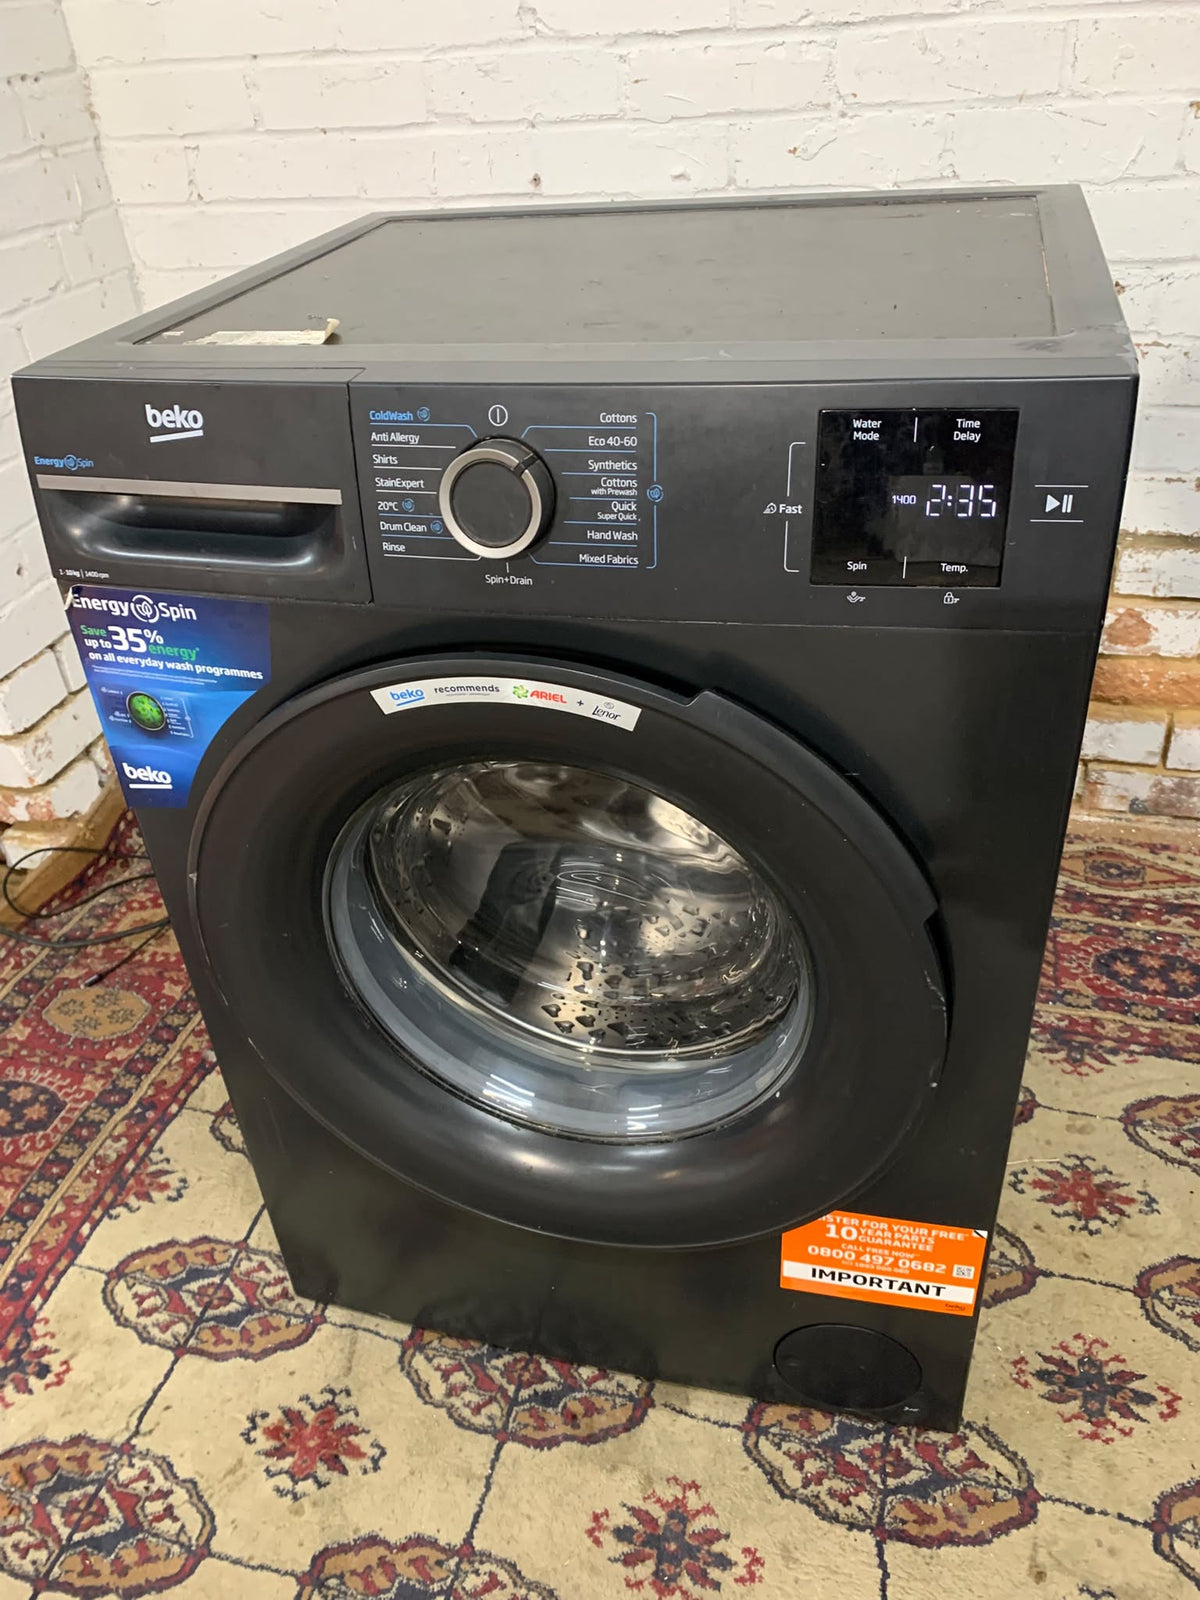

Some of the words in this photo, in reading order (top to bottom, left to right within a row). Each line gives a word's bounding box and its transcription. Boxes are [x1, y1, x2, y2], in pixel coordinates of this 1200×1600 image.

[145, 404, 203, 430] beko
[369, 410, 414, 422] ColdWash
[599, 412, 638, 424] Cottons
[853, 419, 882, 430] Water
[956, 418, 980, 430] Time
[371, 432, 389, 442] Anti
[390, 433, 420, 445] Allergy
[588, 436, 606, 447] Eco
[606, 436, 638, 447] 40-60
[853, 431, 880, 442] Mode
[953, 431, 981, 444] Delay
[33, 456, 64, 468] Energy
[77, 458, 95, 469] Spin
[372, 454, 399, 465] Shirts
[587, 459, 638, 472] Synthetics
[375, 477, 425, 490] StainExpert
[600, 477, 638, 488] Cottons
[591, 487, 606, 496] with
[606, 488, 638, 497] Prewash
[891, 495, 917, 505] 1400
[925, 484, 997, 517] 2:35
[611, 501, 637, 513] Quick
[779, 504, 802, 514] Fast
[597, 512, 617, 522] Super
[618, 513, 637, 522] Quick
[380, 521, 403, 531] Drum
[404, 522, 427, 533] Clean
[587, 530, 612, 540] Hand
[613, 531, 638, 541] Wash
[382, 542, 406, 552] Rinse
[579, 554, 606, 564] Mixed
[606, 555, 639, 566] Fabrics
[847, 561, 867, 573] Spin
[940, 563, 969, 574] Temp.
[485, 574, 533, 586] Spin+Drain
[73, 594, 130, 617] Energy
[158, 602, 197, 621] Spin
[80, 625, 107, 637] Save
[84, 638, 98, 650] up
[99, 638, 112, 649] to
[107, 625, 164, 653] 35%
[88, 651, 103, 661] on
[103, 651, 116, 662] all
[117, 654, 164, 670] everyday
[165, 660, 195, 672] wash
[196, 665, 264, 680] programmes
[390, 688, 425, 702] beko
[433, 684, 501, 695] recommends
[529, 689, 568, 705] ARIEL
[591, 705, 622, 721] Lenor
[122, 762, 172, 785] beko
[819, 1214, 860, 1227] ISTER
[862, 1219, 889, 1231] FOR
[892, 1223, 929, 1237] YOUR
[825, 1223, 858, 1241] 10
[859, 1227, 893, 1239] YEAR
[894, 1231, 935, 1245] PARTS
[841, 1243, 865, 1252] CALL
[866, 1246, 890, 1257] FREE
[858, 1235, 934, 1253] GUARANTEE
[807, 1244, 857, 1261] 0800
[859, 1253, 895, 1266] 497
[898, 1258, 948, 1275] 0682
[811, 1267, 947, 1298] IMPORTANT
